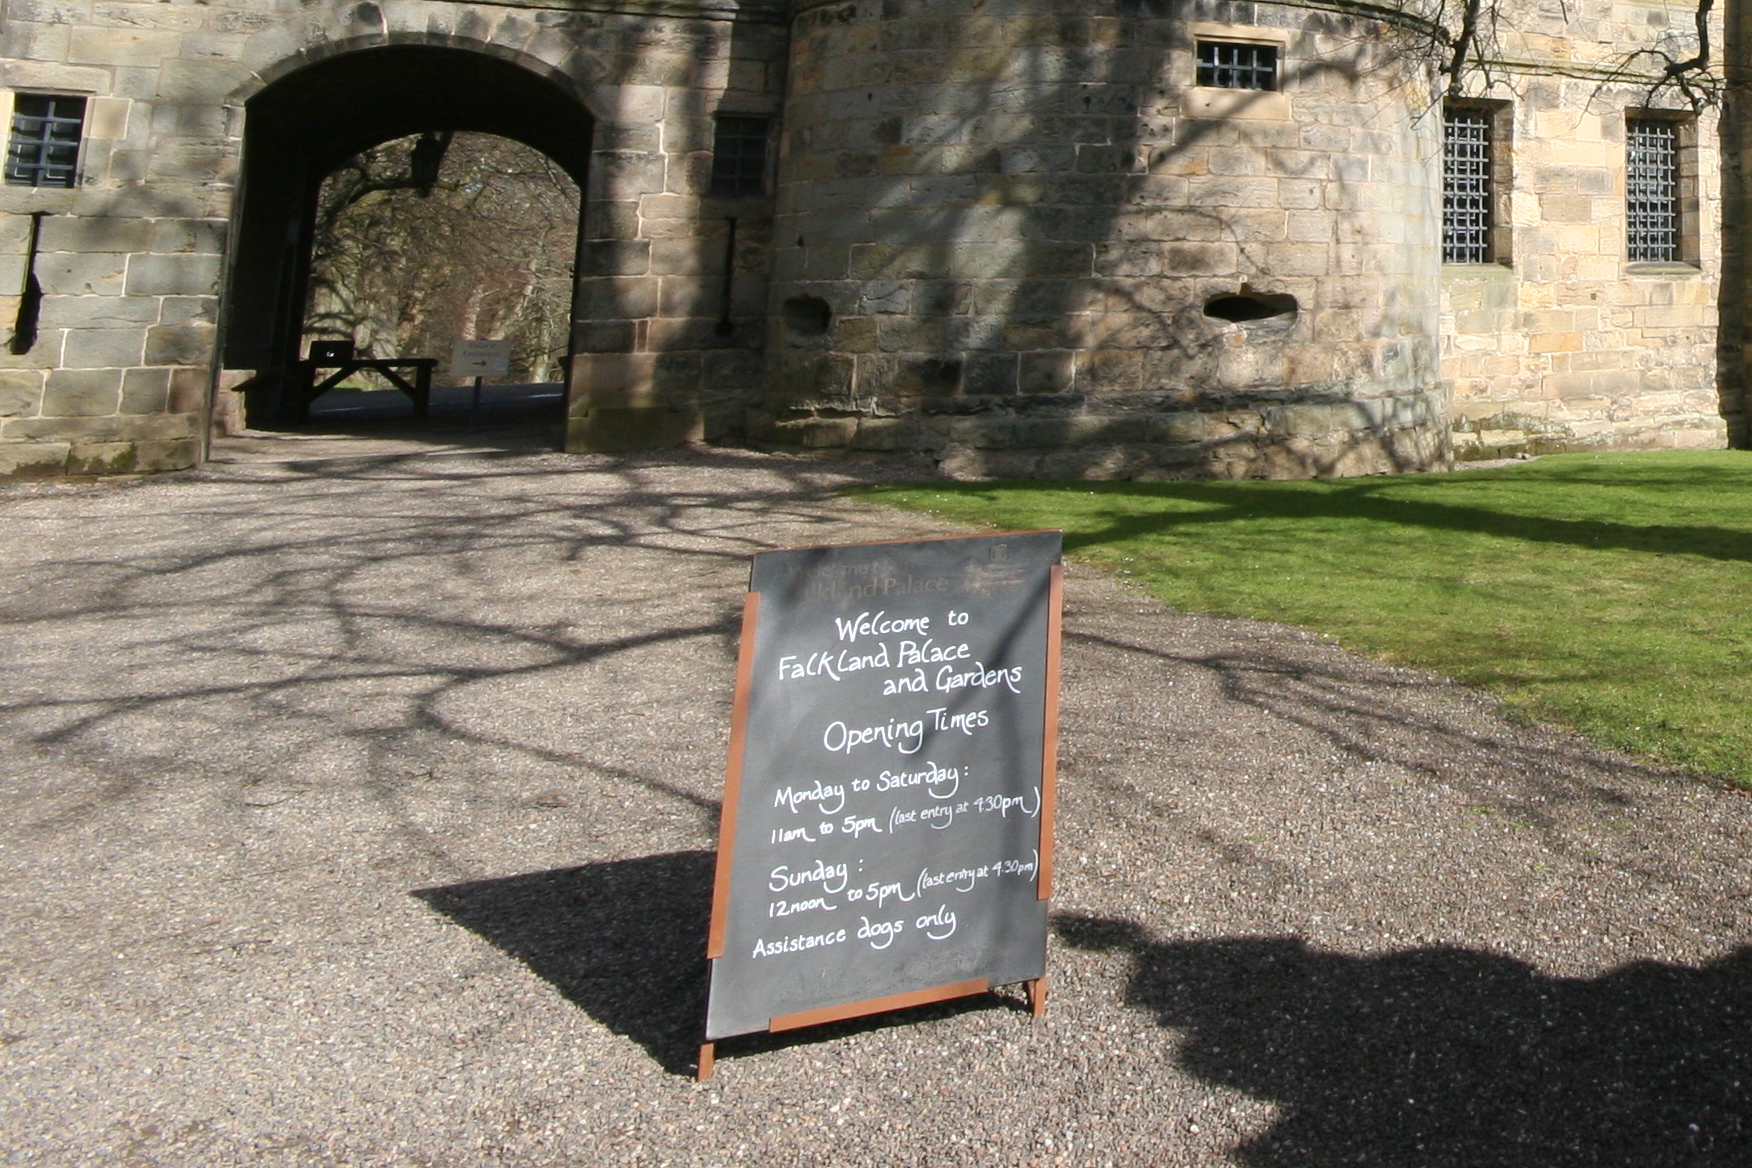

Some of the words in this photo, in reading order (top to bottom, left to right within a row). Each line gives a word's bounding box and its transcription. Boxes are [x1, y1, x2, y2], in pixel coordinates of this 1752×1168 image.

[834, 610, 930, 643] Welcome
[948, 610, 969, 626] to
[896, 636, 971, 669] Palace
[883, 668, 929, 696] and
[935, 661, 1023, 694] Gardens
[823, 718, 924, 755] Opening
[926, 706, 989, 736] Times
[773, 779, 845, 816] Monday
[851, 778, 871, 792] to
[770, 827, 816, 845] 11am
[819, 820, 834, 835] to
[841, 814, 883, 840] 5pm
[888, 806, 917, 835] (last
[919, 805, 953, 830] entry
[955, 799, 969, 814] at
[846, 888, 864, 902] to
[864, 881, 916, 909] 5pm
[916, 867, 945, 898] (last
[945, 868, 977, 893] entry
[976, 864, 990, 878] at
[991, 848, 1039, 882] 4.30pm)
[752, 929, 847, 959] Assistance
[857, 915, 905, 950] dogs
[916, 903, 957, 941] only
